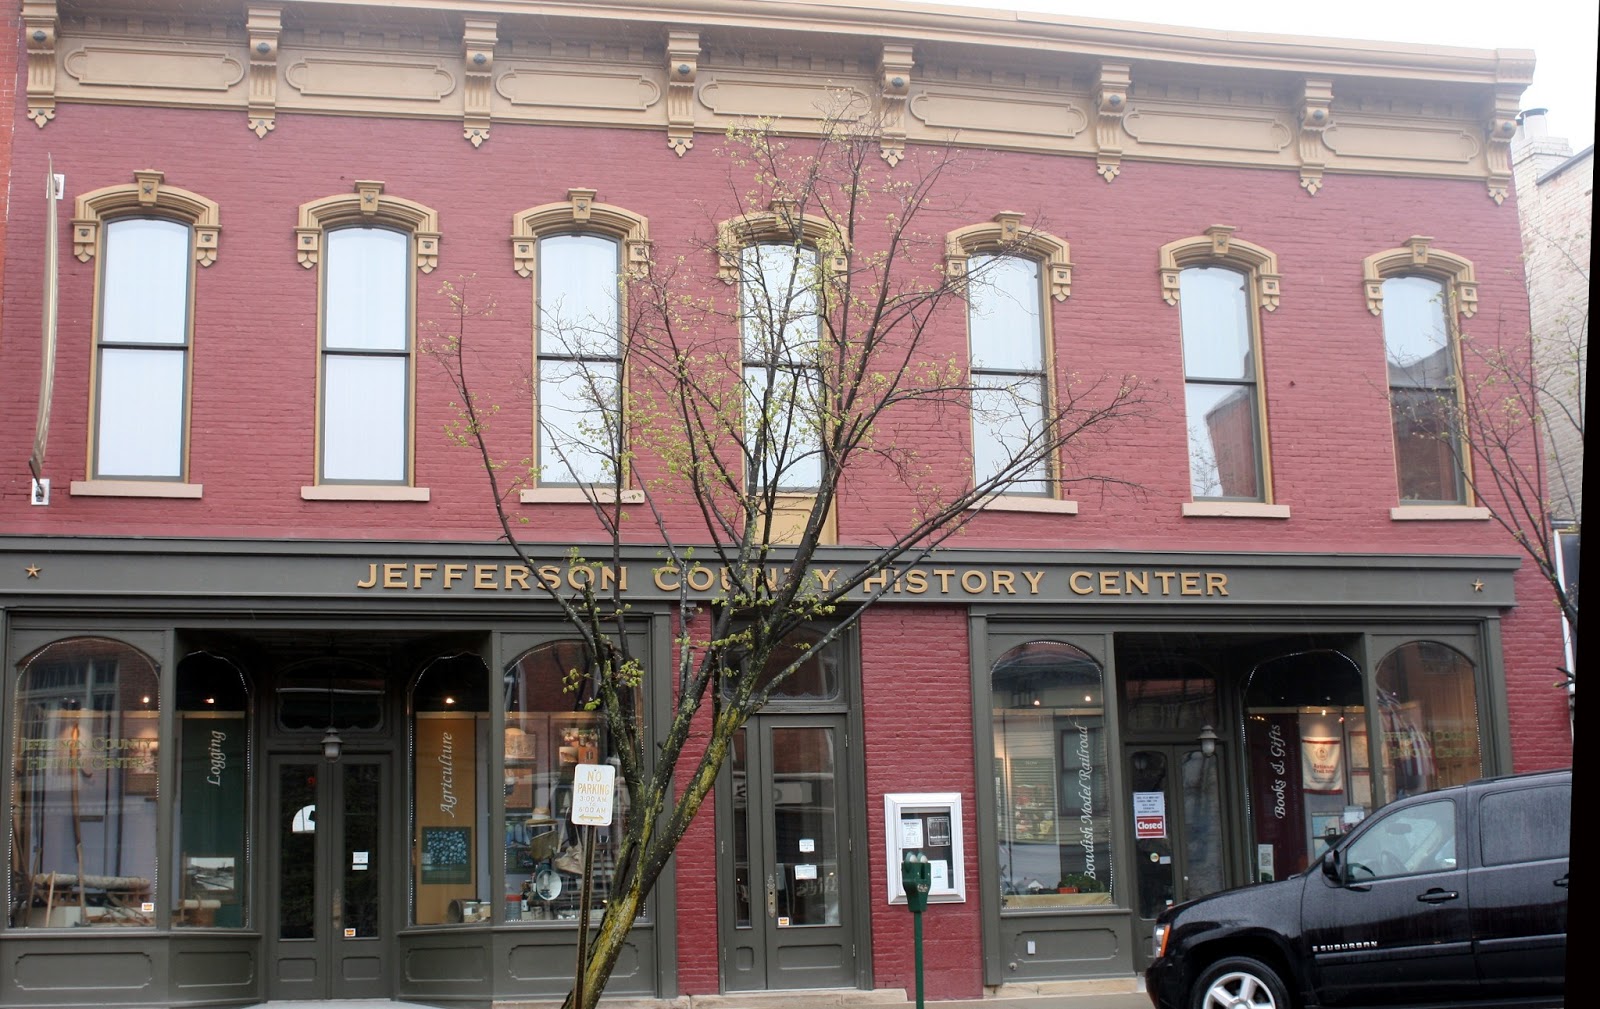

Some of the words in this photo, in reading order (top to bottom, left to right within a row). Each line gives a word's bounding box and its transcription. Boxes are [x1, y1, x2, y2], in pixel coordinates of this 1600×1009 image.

[357, 563, 628, 591] JEFFERSON
[654, 566, 838, 592] CONY
[863, 569, 1045, 594] HISTORY
[1069, 570, 1229, 596] CENTER
[206, 730, 227, 786] Logging
[1074, 721, 1093, 780] Railroad
[1268, 724, 1286, 757] Gifts
[437, 732, 458, 818] Agriculture
[577, 783, 610, 796] PARKING
[587, 770, 602, 782] NO
[1078, 780, 1093, 825] Model
[1271, 779, 1287, 819] Books
[1137, 820, 1163, 830] Closed
[1080, 826, 1096, 880] Bowdish
[1320, 940, 1378, 952] SUBURBAN
